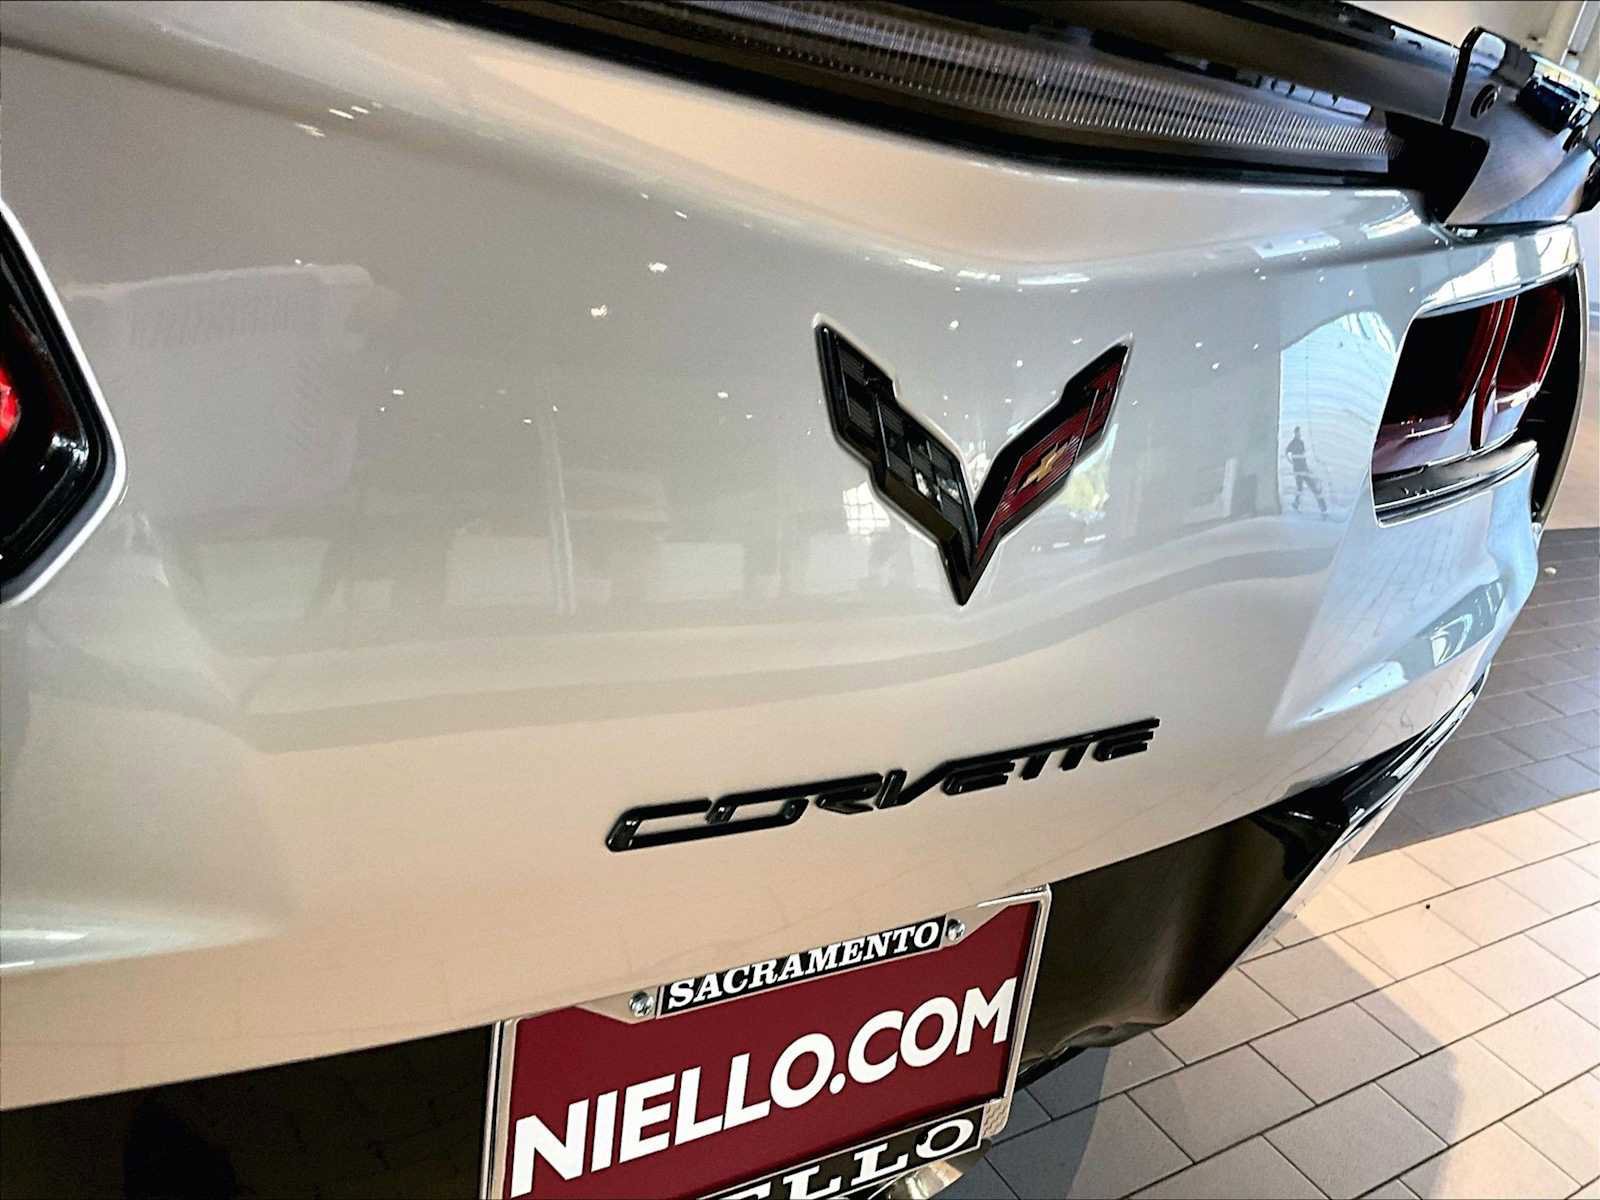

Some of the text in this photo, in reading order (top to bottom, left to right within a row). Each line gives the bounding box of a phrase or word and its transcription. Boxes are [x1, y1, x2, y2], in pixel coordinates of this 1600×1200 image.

[605, 717, 1160, 852] CORVETTE
[668, 921, 939, 1009] SACRAMENTO
[511, 977, 1018, 1198] NIELLO.COM
